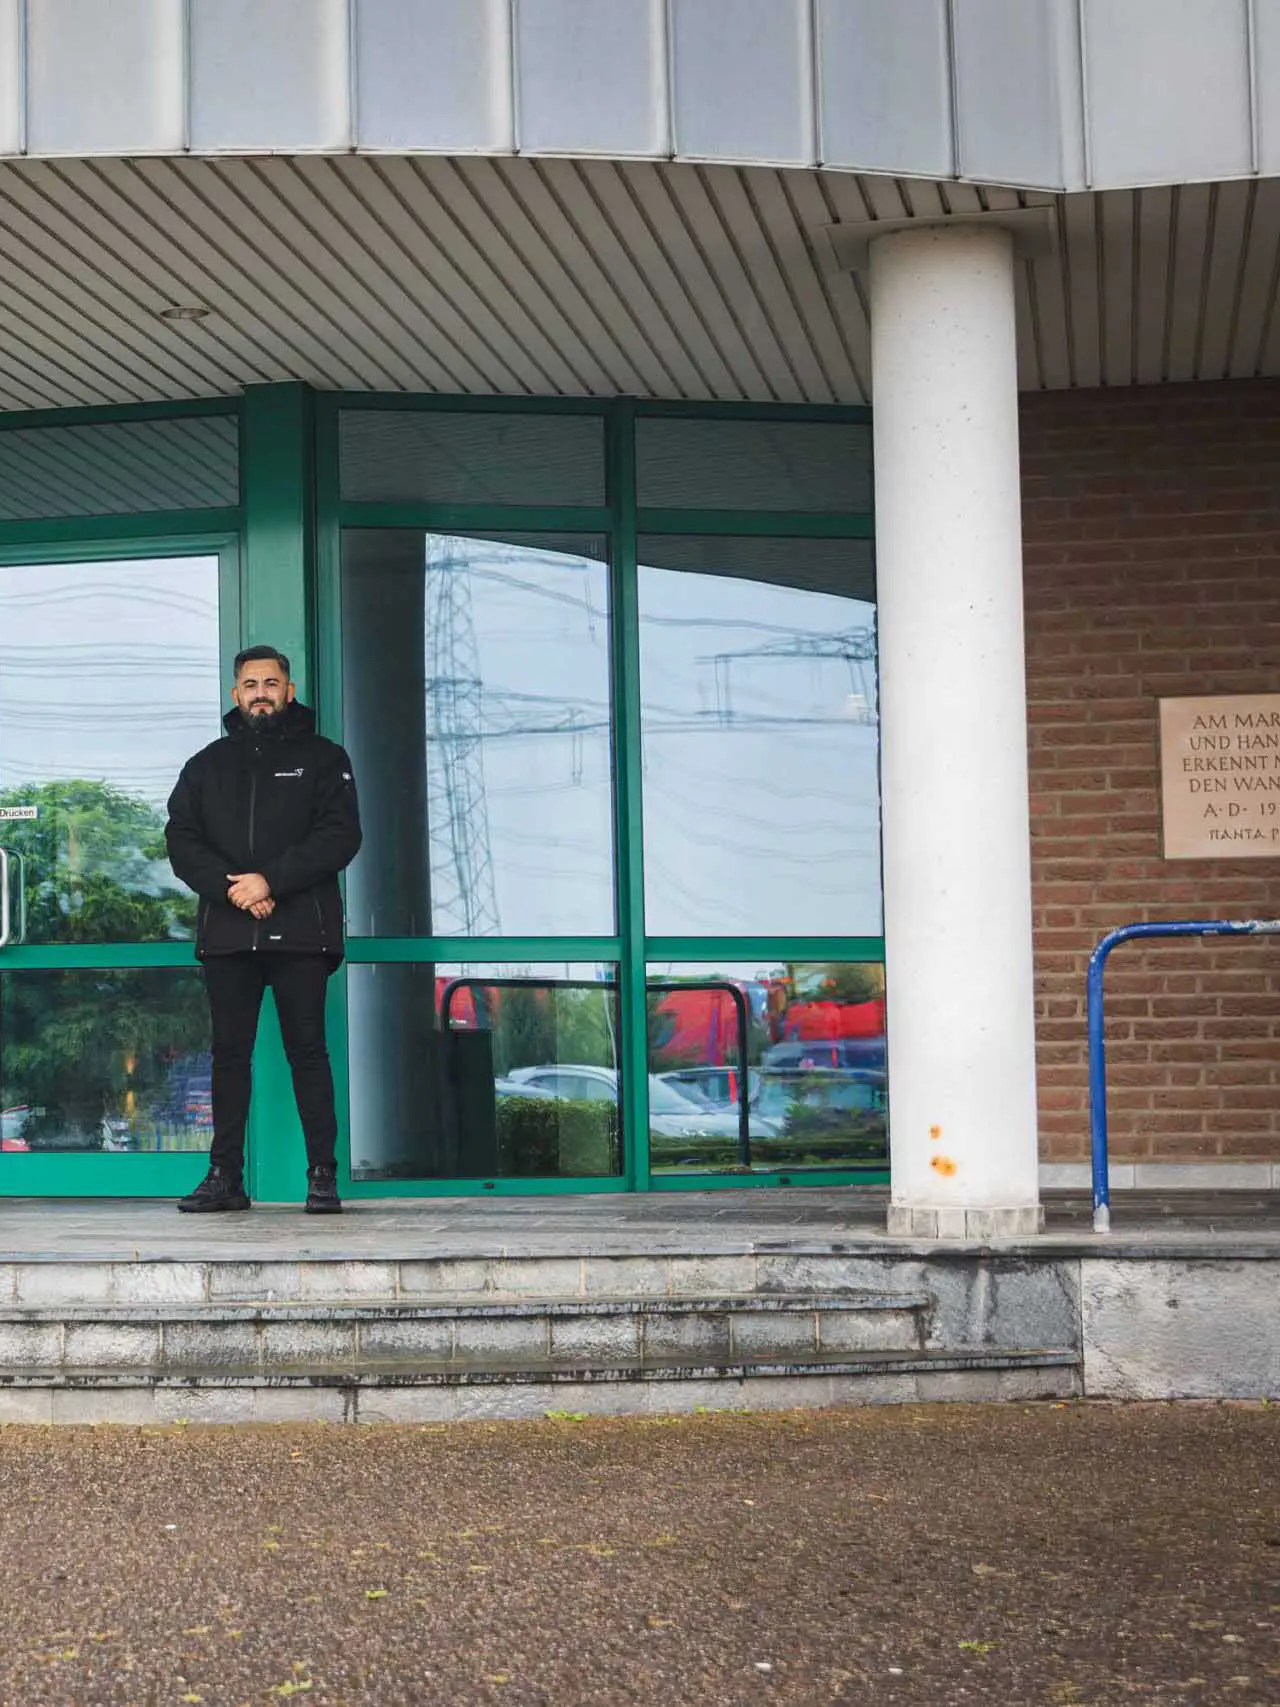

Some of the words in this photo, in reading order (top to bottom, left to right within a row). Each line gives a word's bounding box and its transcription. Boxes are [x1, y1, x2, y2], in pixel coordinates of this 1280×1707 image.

[1192, 714, 1227, 730] AM
[1189, 735, 1231, 751] UND
[1237, 733, 1279, 750] HAN
[1183, 755, 1269, 772] ERKENNT
[1189, 777, 1227, 793] DEN
[1233, 775, 1280, 792] WAN
